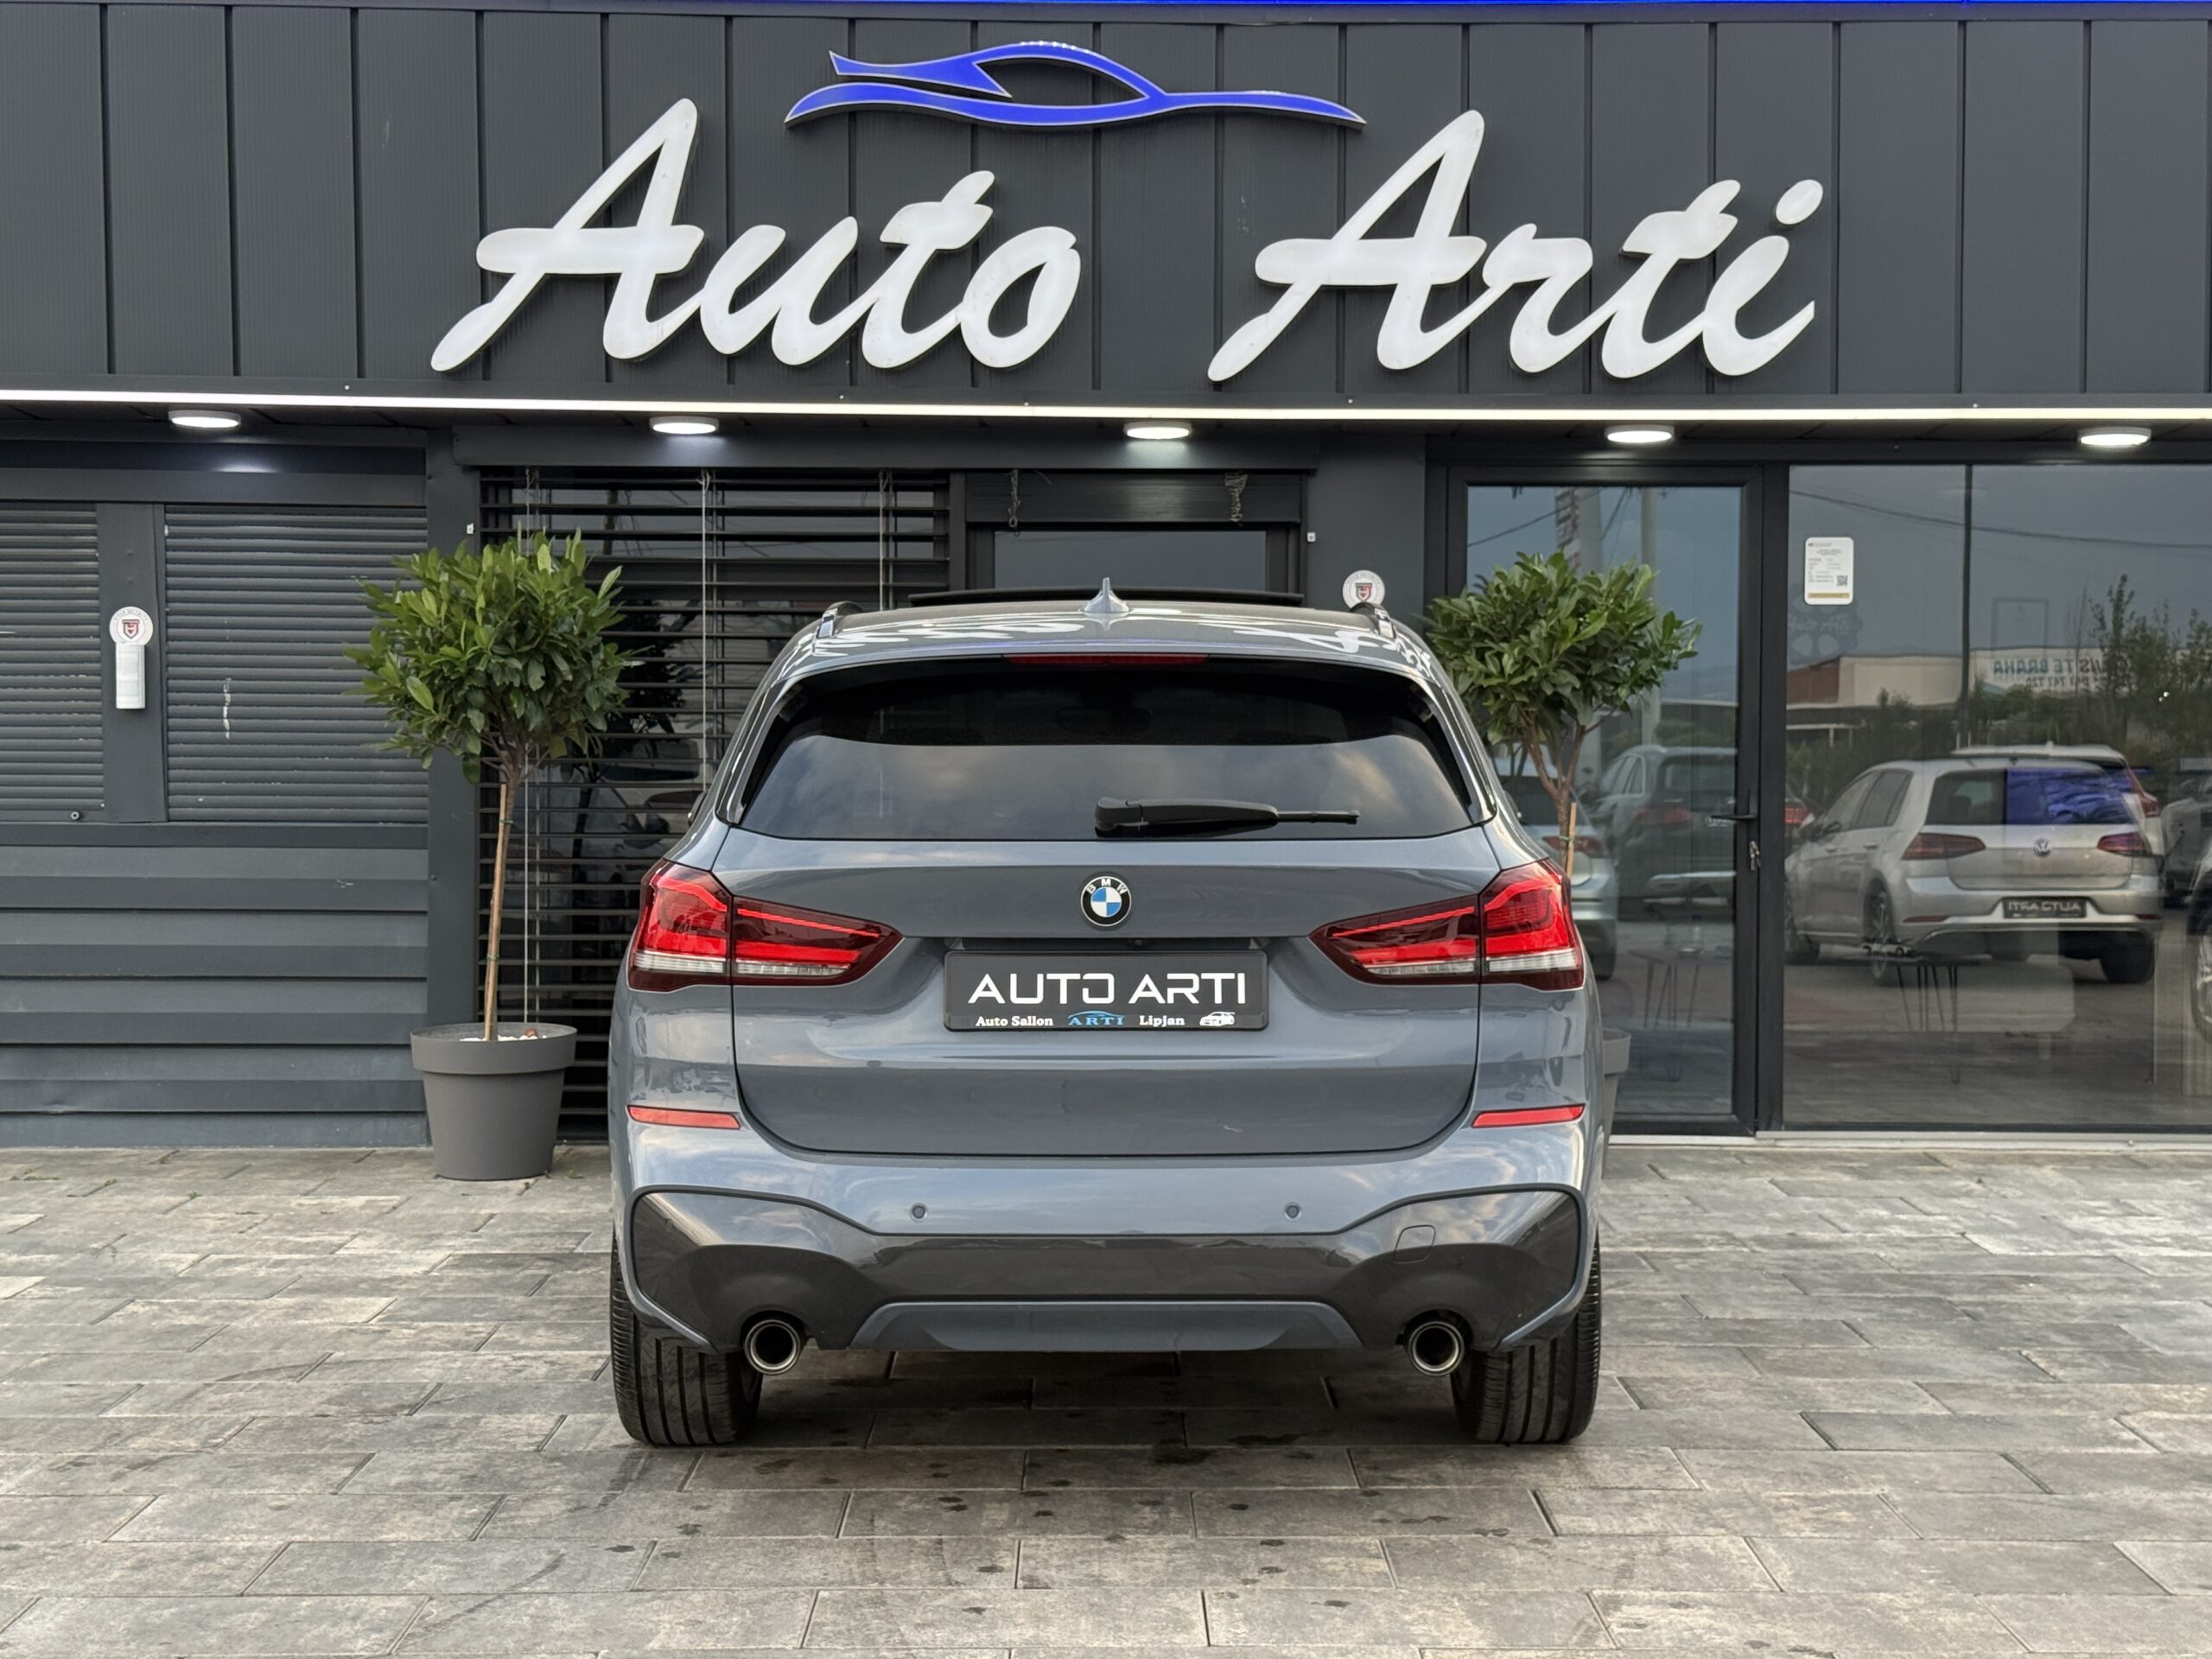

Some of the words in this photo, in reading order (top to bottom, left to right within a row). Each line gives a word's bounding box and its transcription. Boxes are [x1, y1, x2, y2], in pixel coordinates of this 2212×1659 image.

[431, 98, 1081, 372] Auto
[1208, 110, 1823, 382] Arti
[1085, 878, 1128, 894] BMW
[968, 973, 1115, 1004] AUTO
[1128, 972, 1246, 1004] ARTI
[976, 1015, 1008, 1027] Auto
[1011, 1015, 1054, 1027] Sallon
[1068, 1016, 1125, 1027] ARTI
[1139, 1014, 1185, 1027] Lipjan
